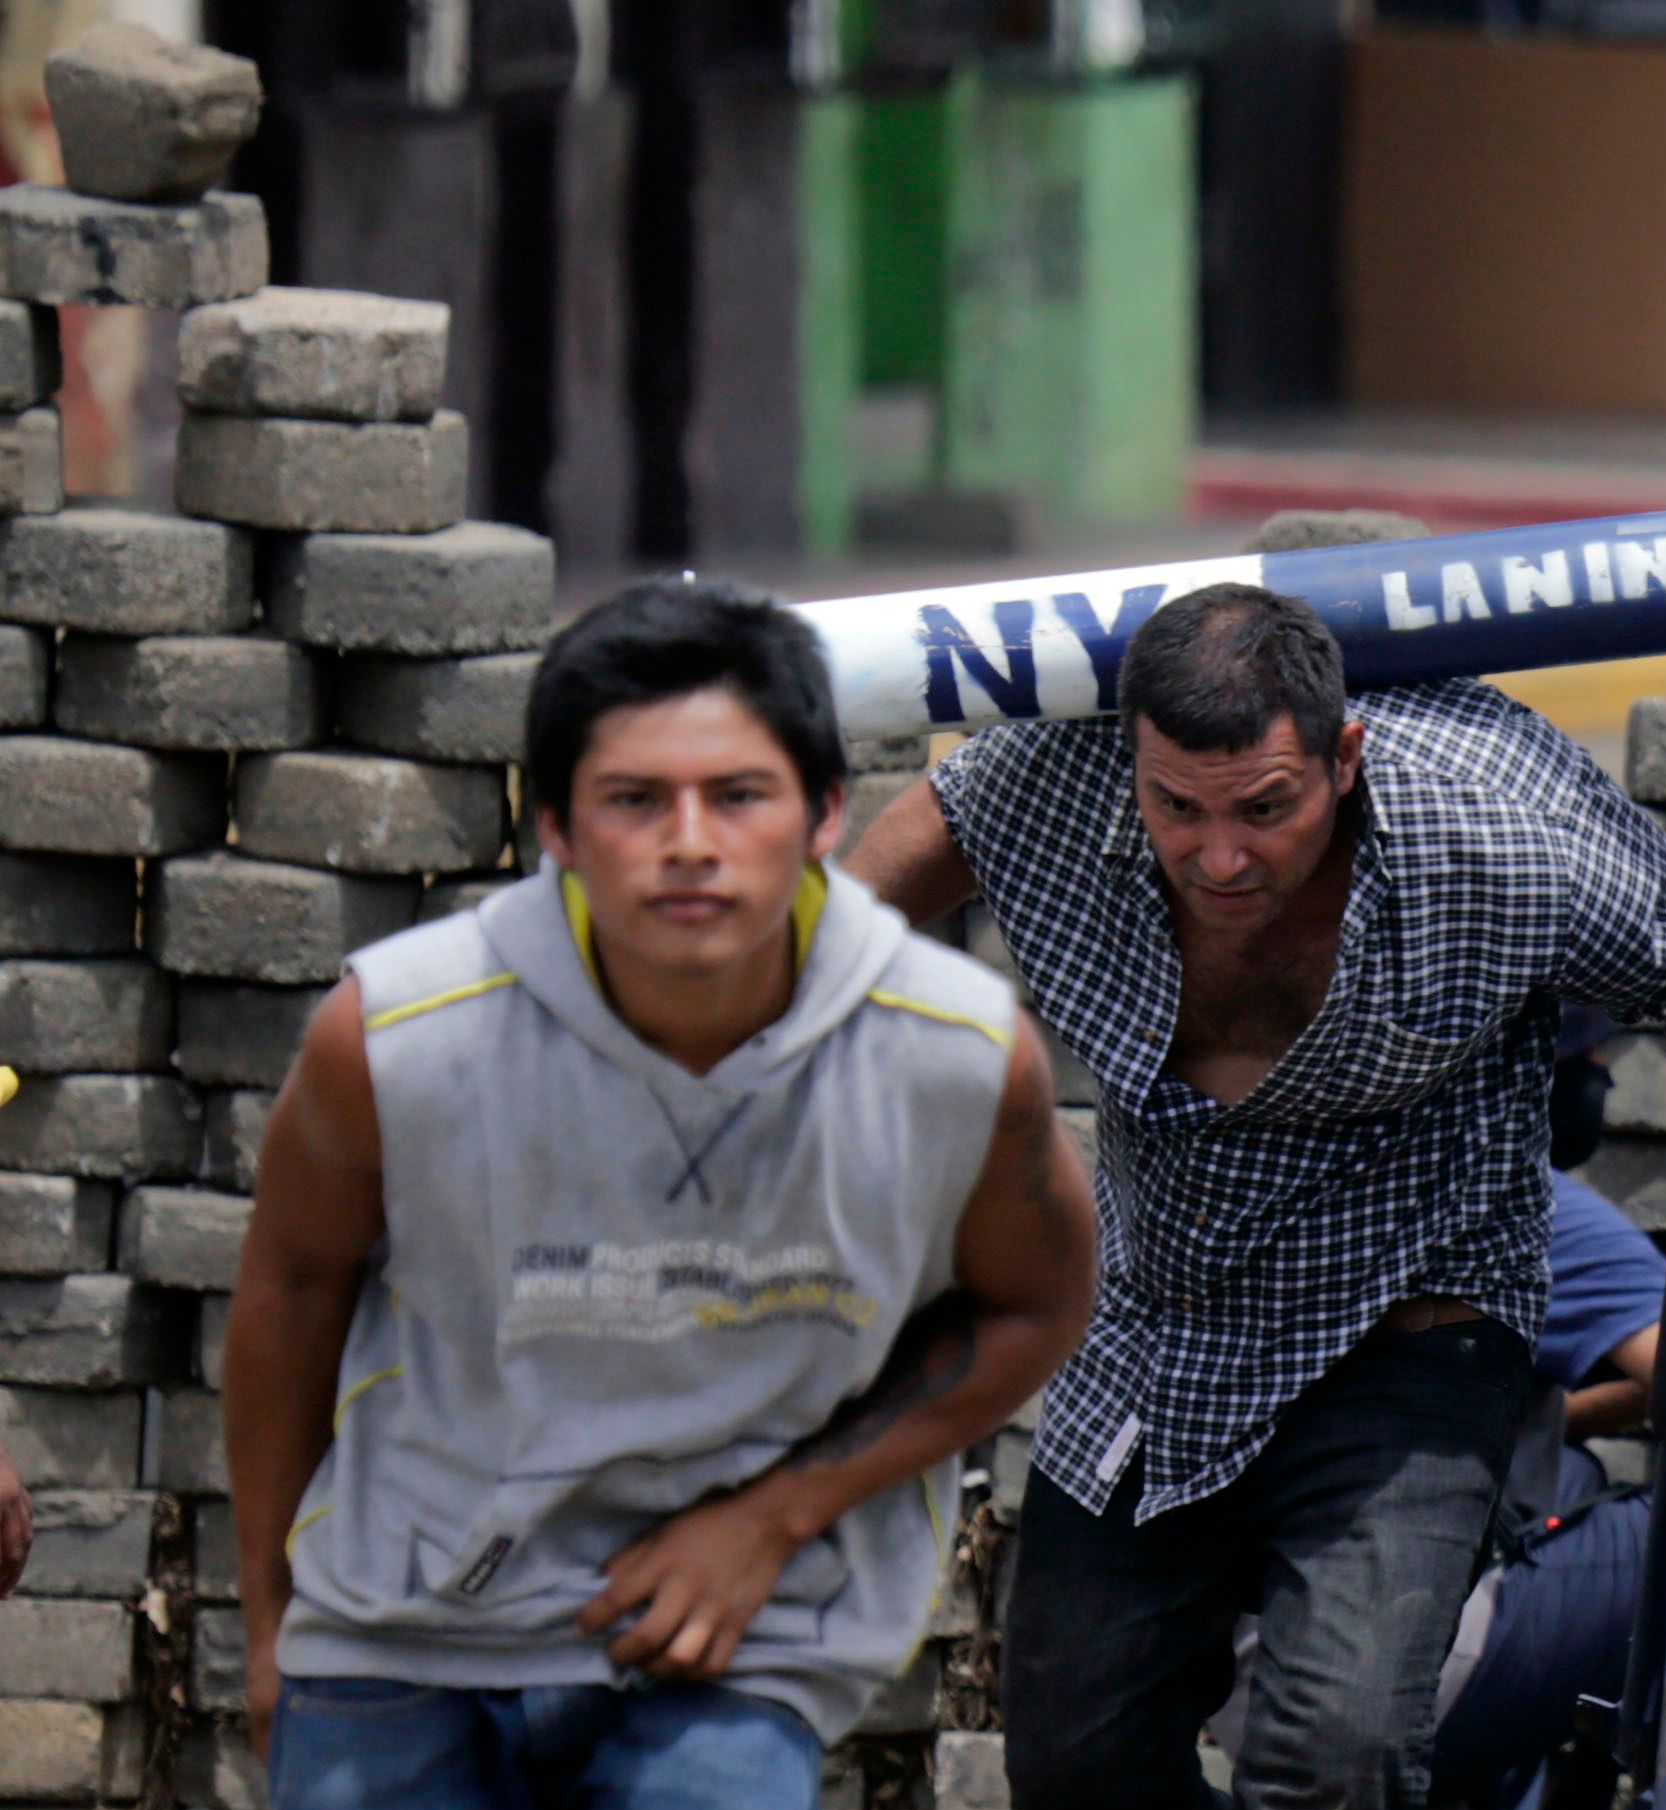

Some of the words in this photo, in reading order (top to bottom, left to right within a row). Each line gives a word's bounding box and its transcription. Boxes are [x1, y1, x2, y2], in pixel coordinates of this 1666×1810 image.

[512, 1244, 593, 1273] DENIM
[594, 1238, 712, 1275] PRODUCTS
[713, 1243, 829, 1283] STANDARD
[513, 1272, 588, 1301] WORK
